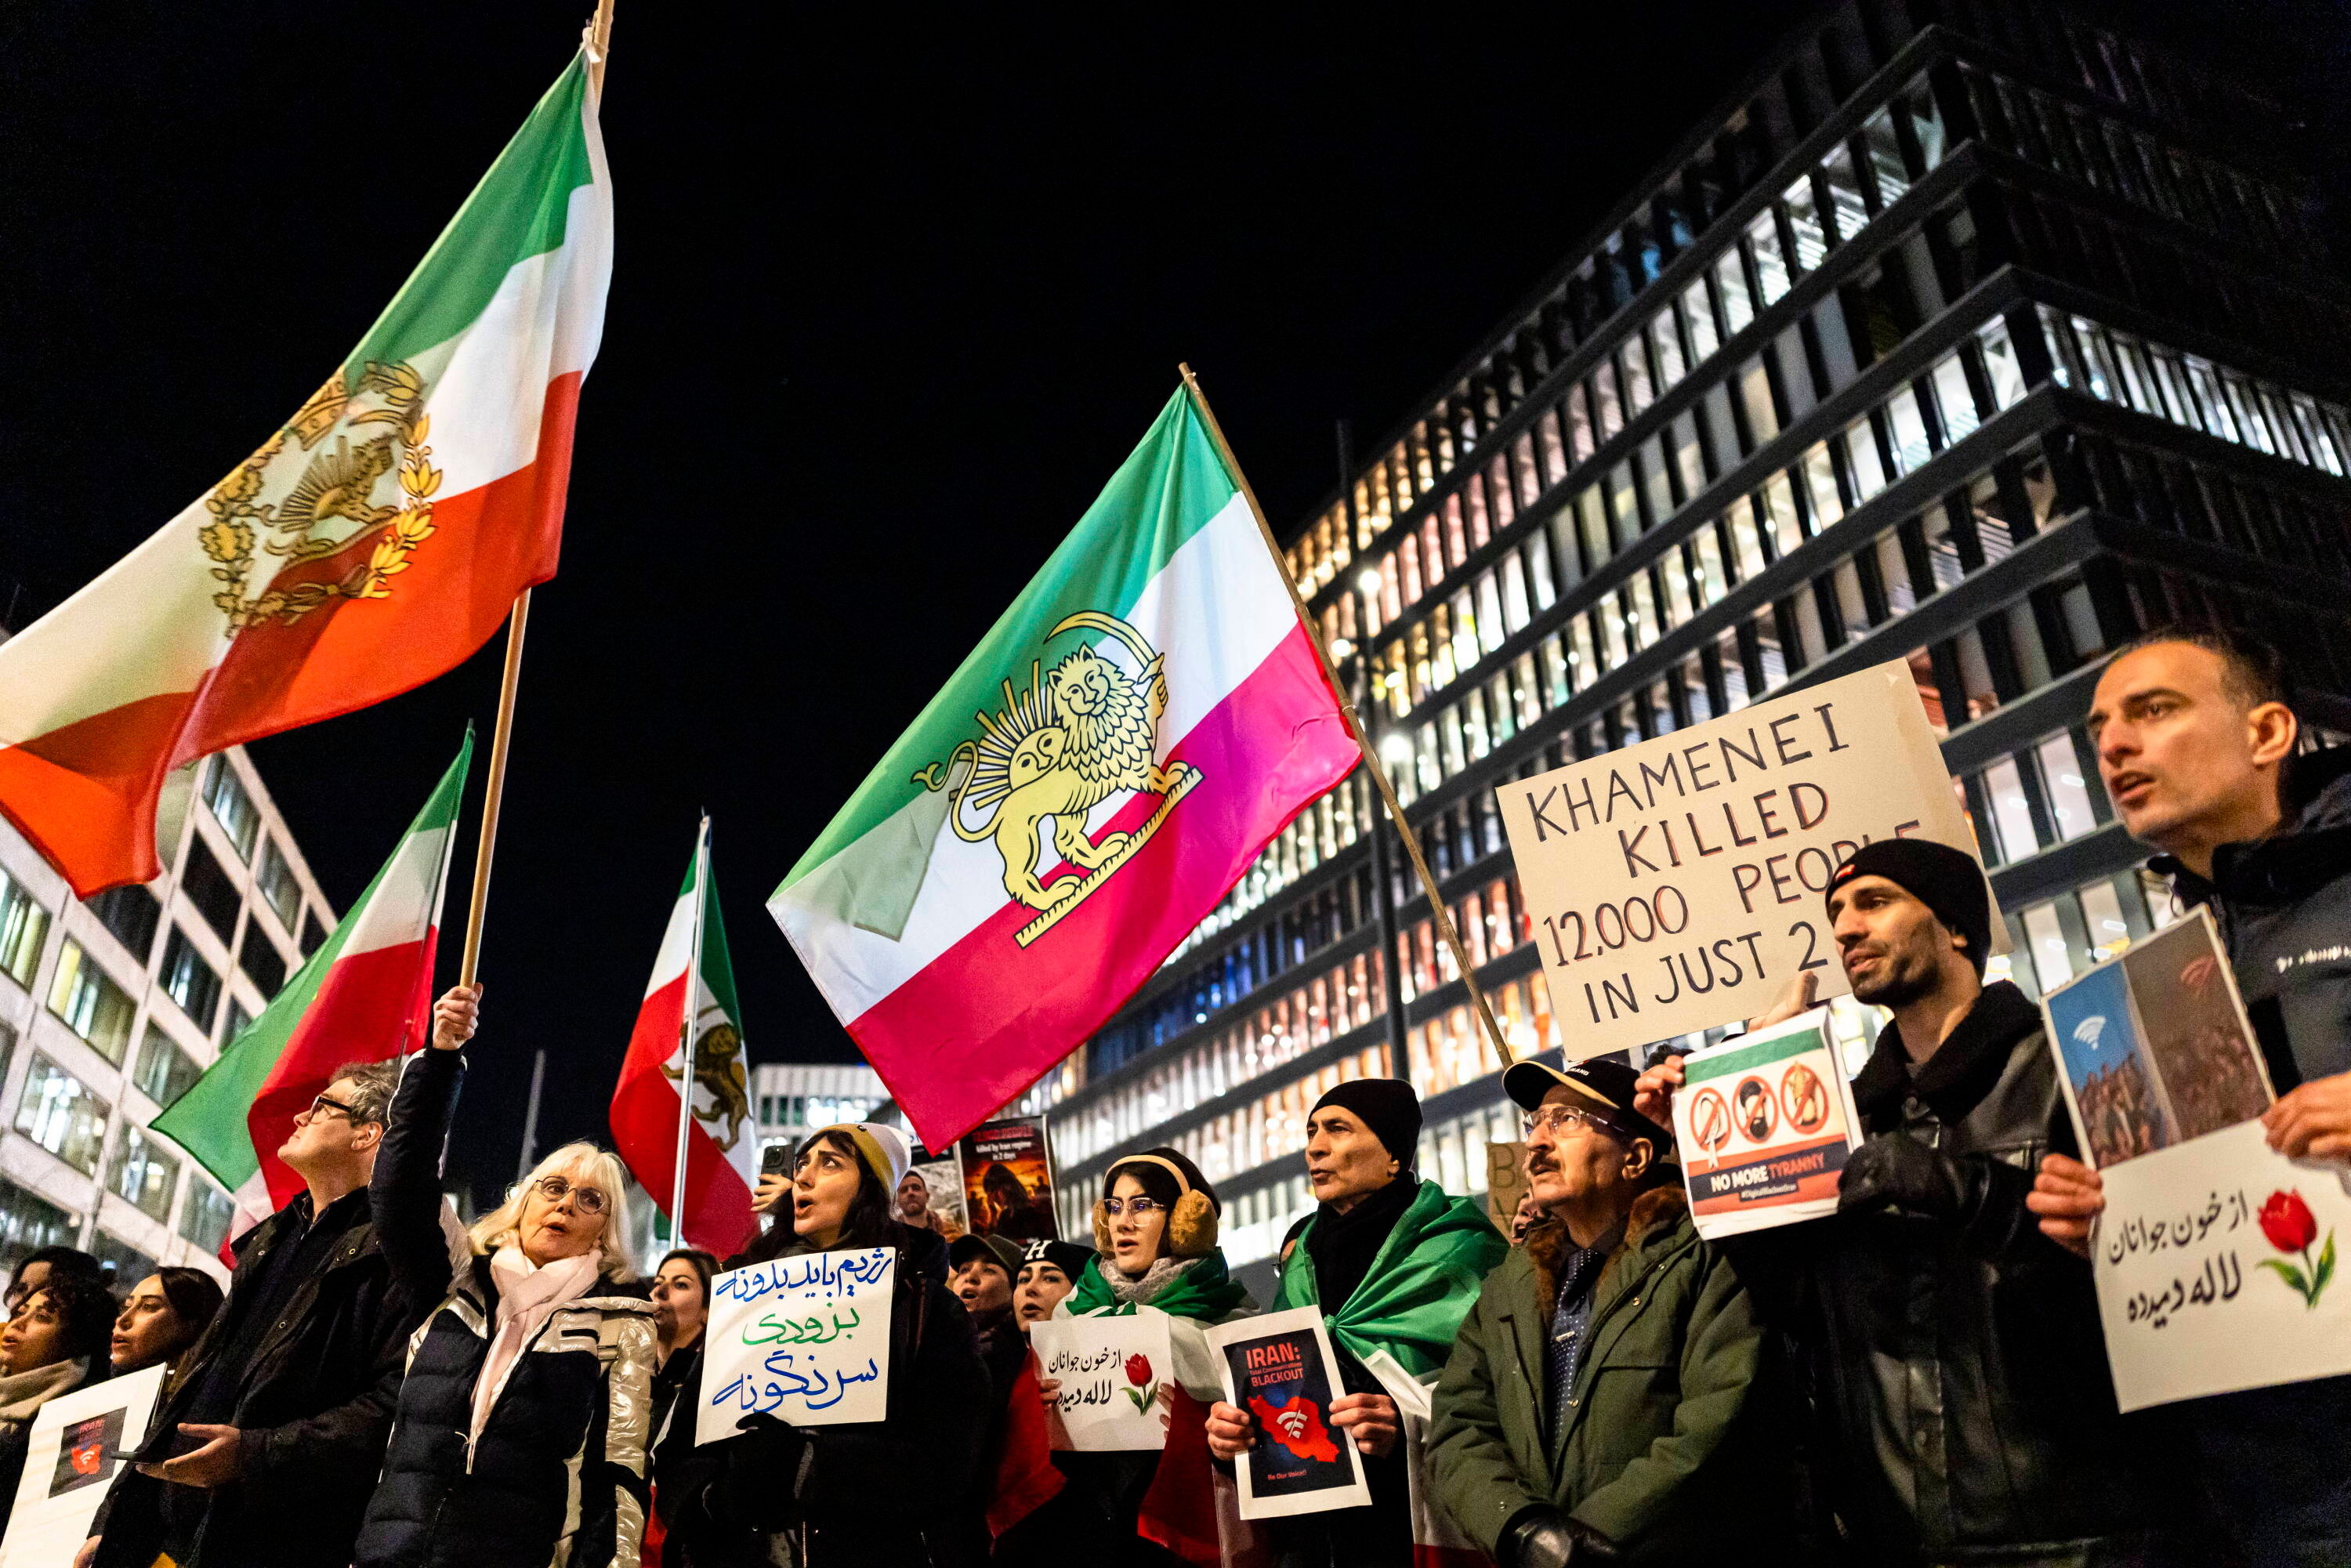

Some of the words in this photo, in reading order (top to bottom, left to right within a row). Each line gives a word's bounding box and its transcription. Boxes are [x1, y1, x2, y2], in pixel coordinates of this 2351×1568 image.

[1526, 703, 1849, 842] KHAMENEI
[1618, 782, 1829, 878] KILLED
[1584, 972, 1639, 1023] IN
[1654, 932, 1762, 1005] JUST
[1788, 922, 1828, 972] 2
[1710, 1174, 1730, 1193] NO
[1731, 1165, 1769, 1188] MORE
[1768, 1152, 1824, 1179] TYRANNY
[2172, 1191, 2222, 1247] خون
[2227, 1187, 2248, 1232] از
[1025, 1240, 1053, 1260] H
[2108, 1215, 2168, 1266] جوانان
[788, 1252, 835, 1298] باید
[837, 1248, 892, 1298] رژیم
[2190, 1249, 2241, 1305] لاله
[742, 1302, 860, 1345] بزودی
[1049, 1349, 1079, 1374] جوانان
[1081, 1346, 1109, 1372] خون
[1110, 1348, 1121, 1369] از
[1246, 1342, 1301, 1369] IRAN:
[1252, 1367, 1303, 1386] BLACKOUT
[1083, 1378, 1111, 1405] لاله
